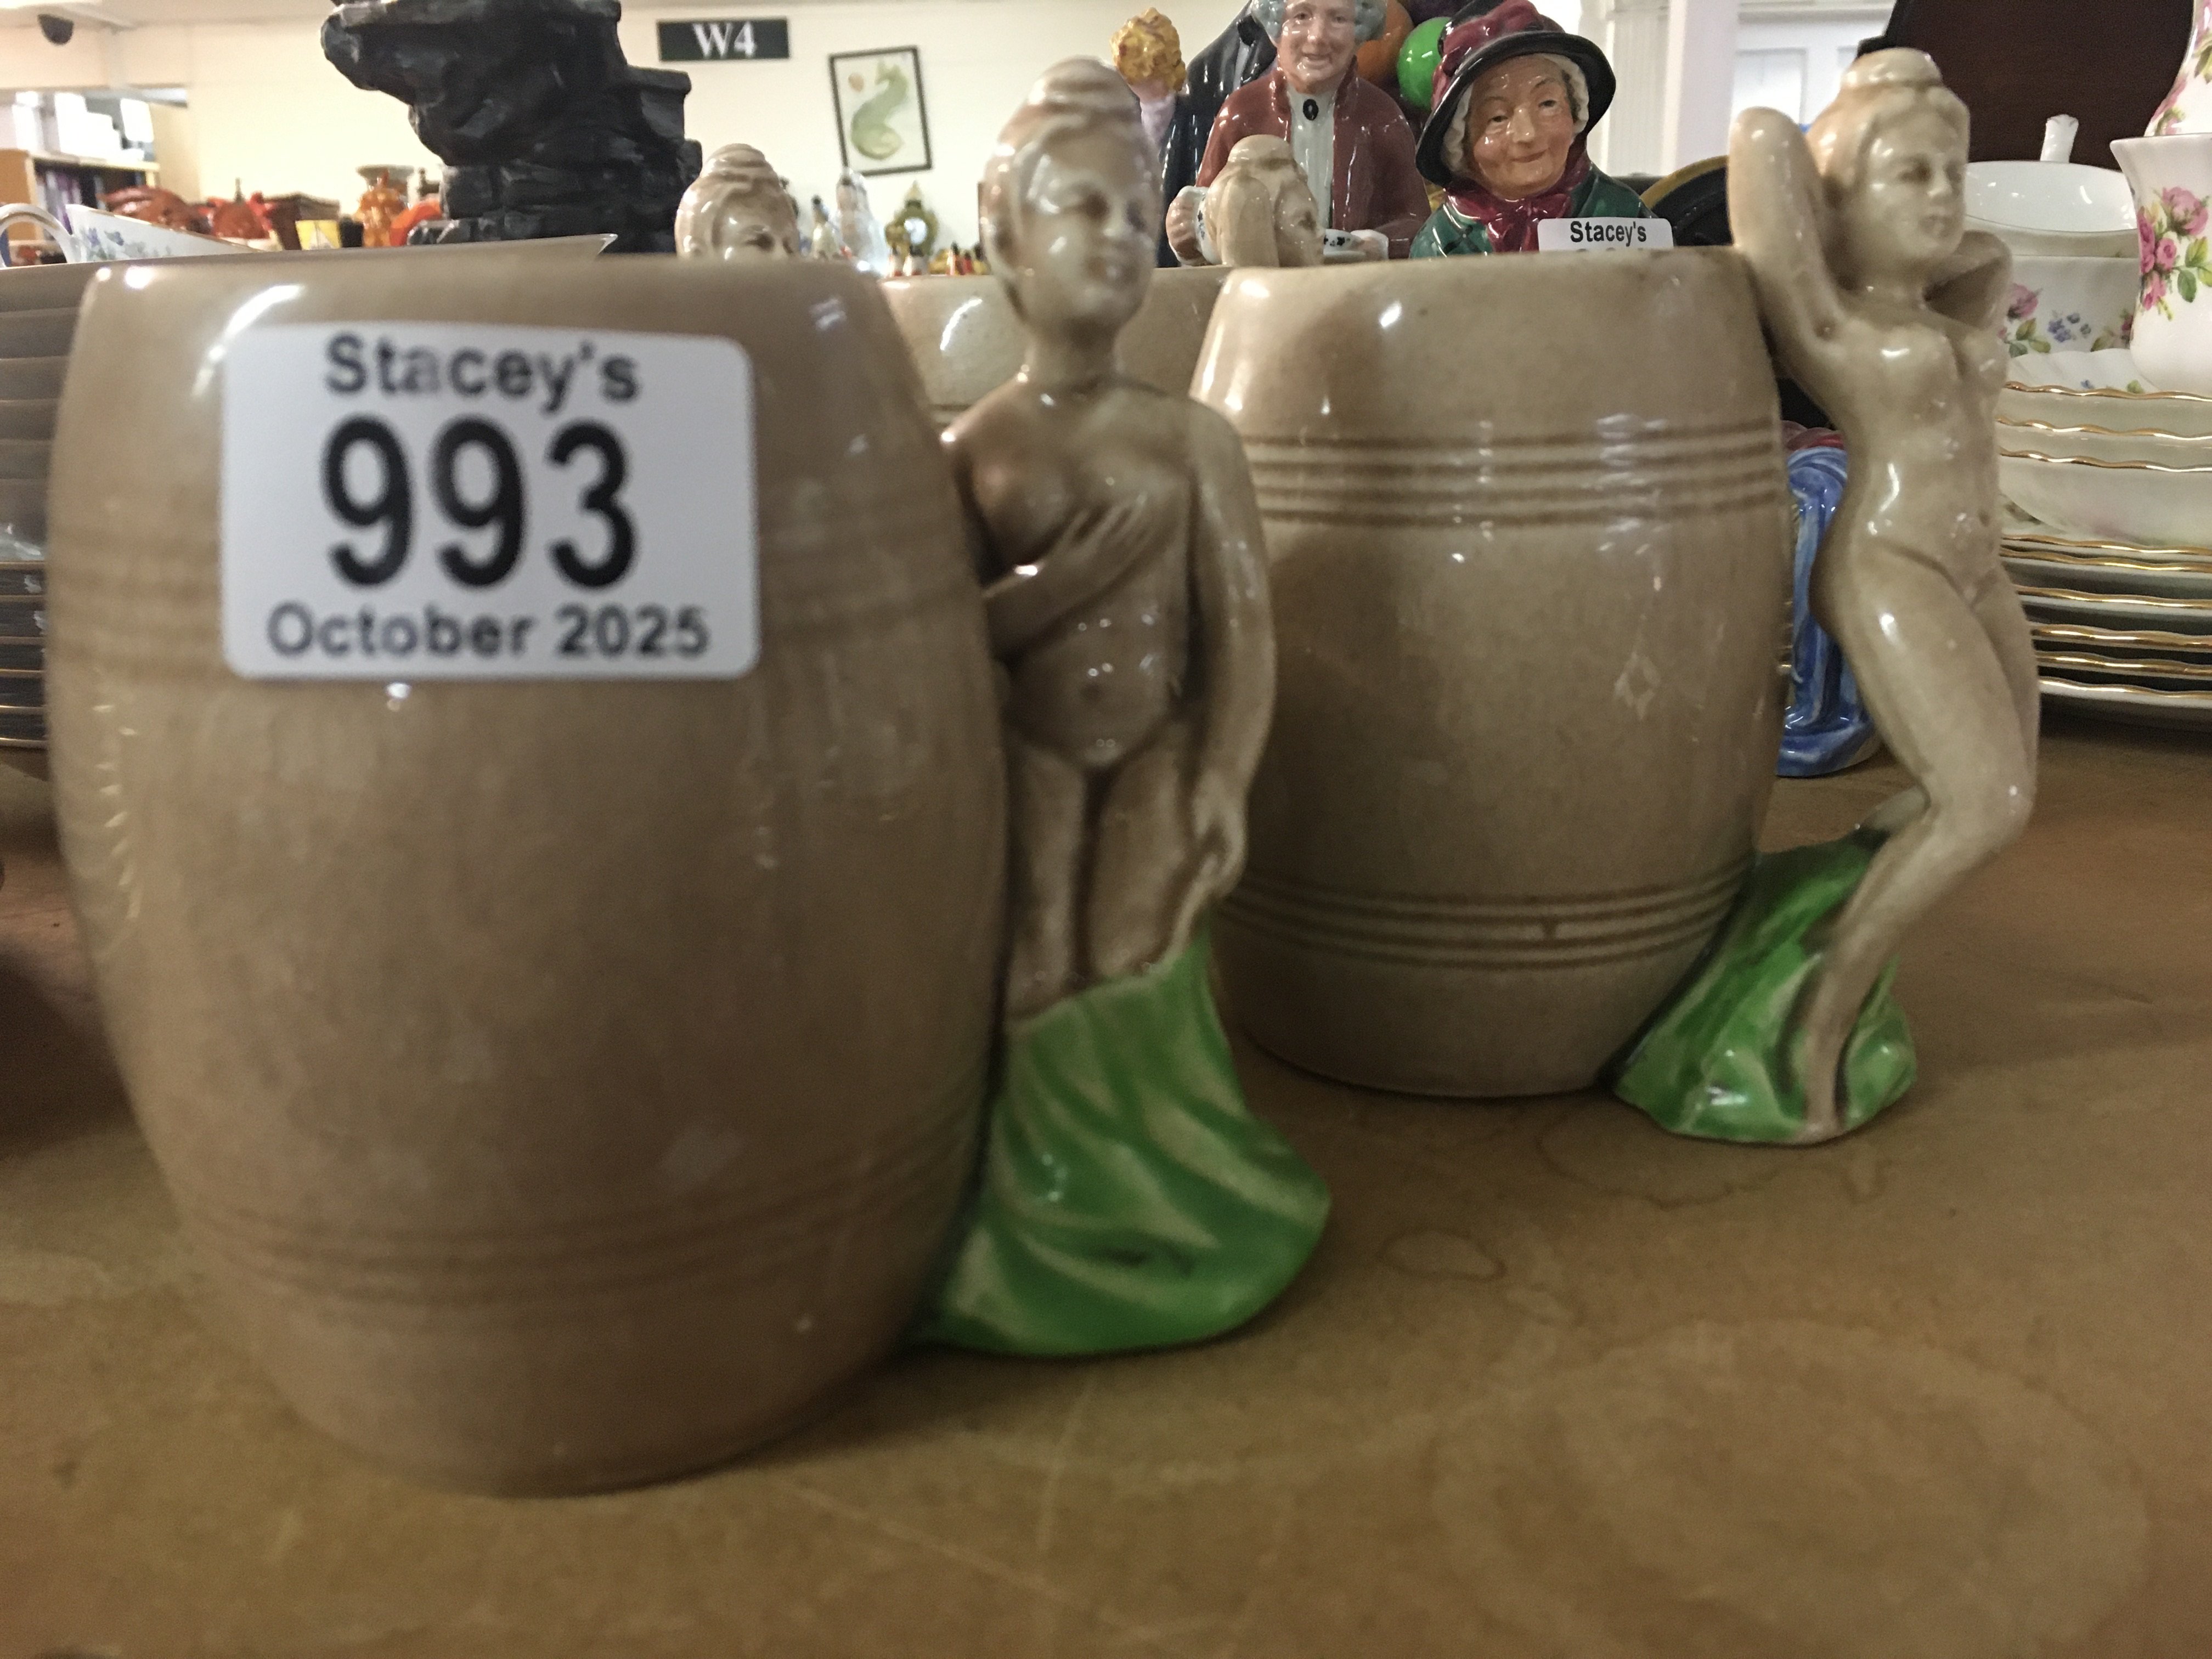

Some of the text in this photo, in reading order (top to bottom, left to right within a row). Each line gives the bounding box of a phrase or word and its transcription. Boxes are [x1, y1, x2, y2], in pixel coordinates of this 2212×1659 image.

[692, 21, 758, 58] W4
[1570, 221, 1647, 247] Stacey's
[325, 332, 639, 414] Stacey's
[321, 415, 637, 589] 993
[267, 600, 710, 657] October 2025
